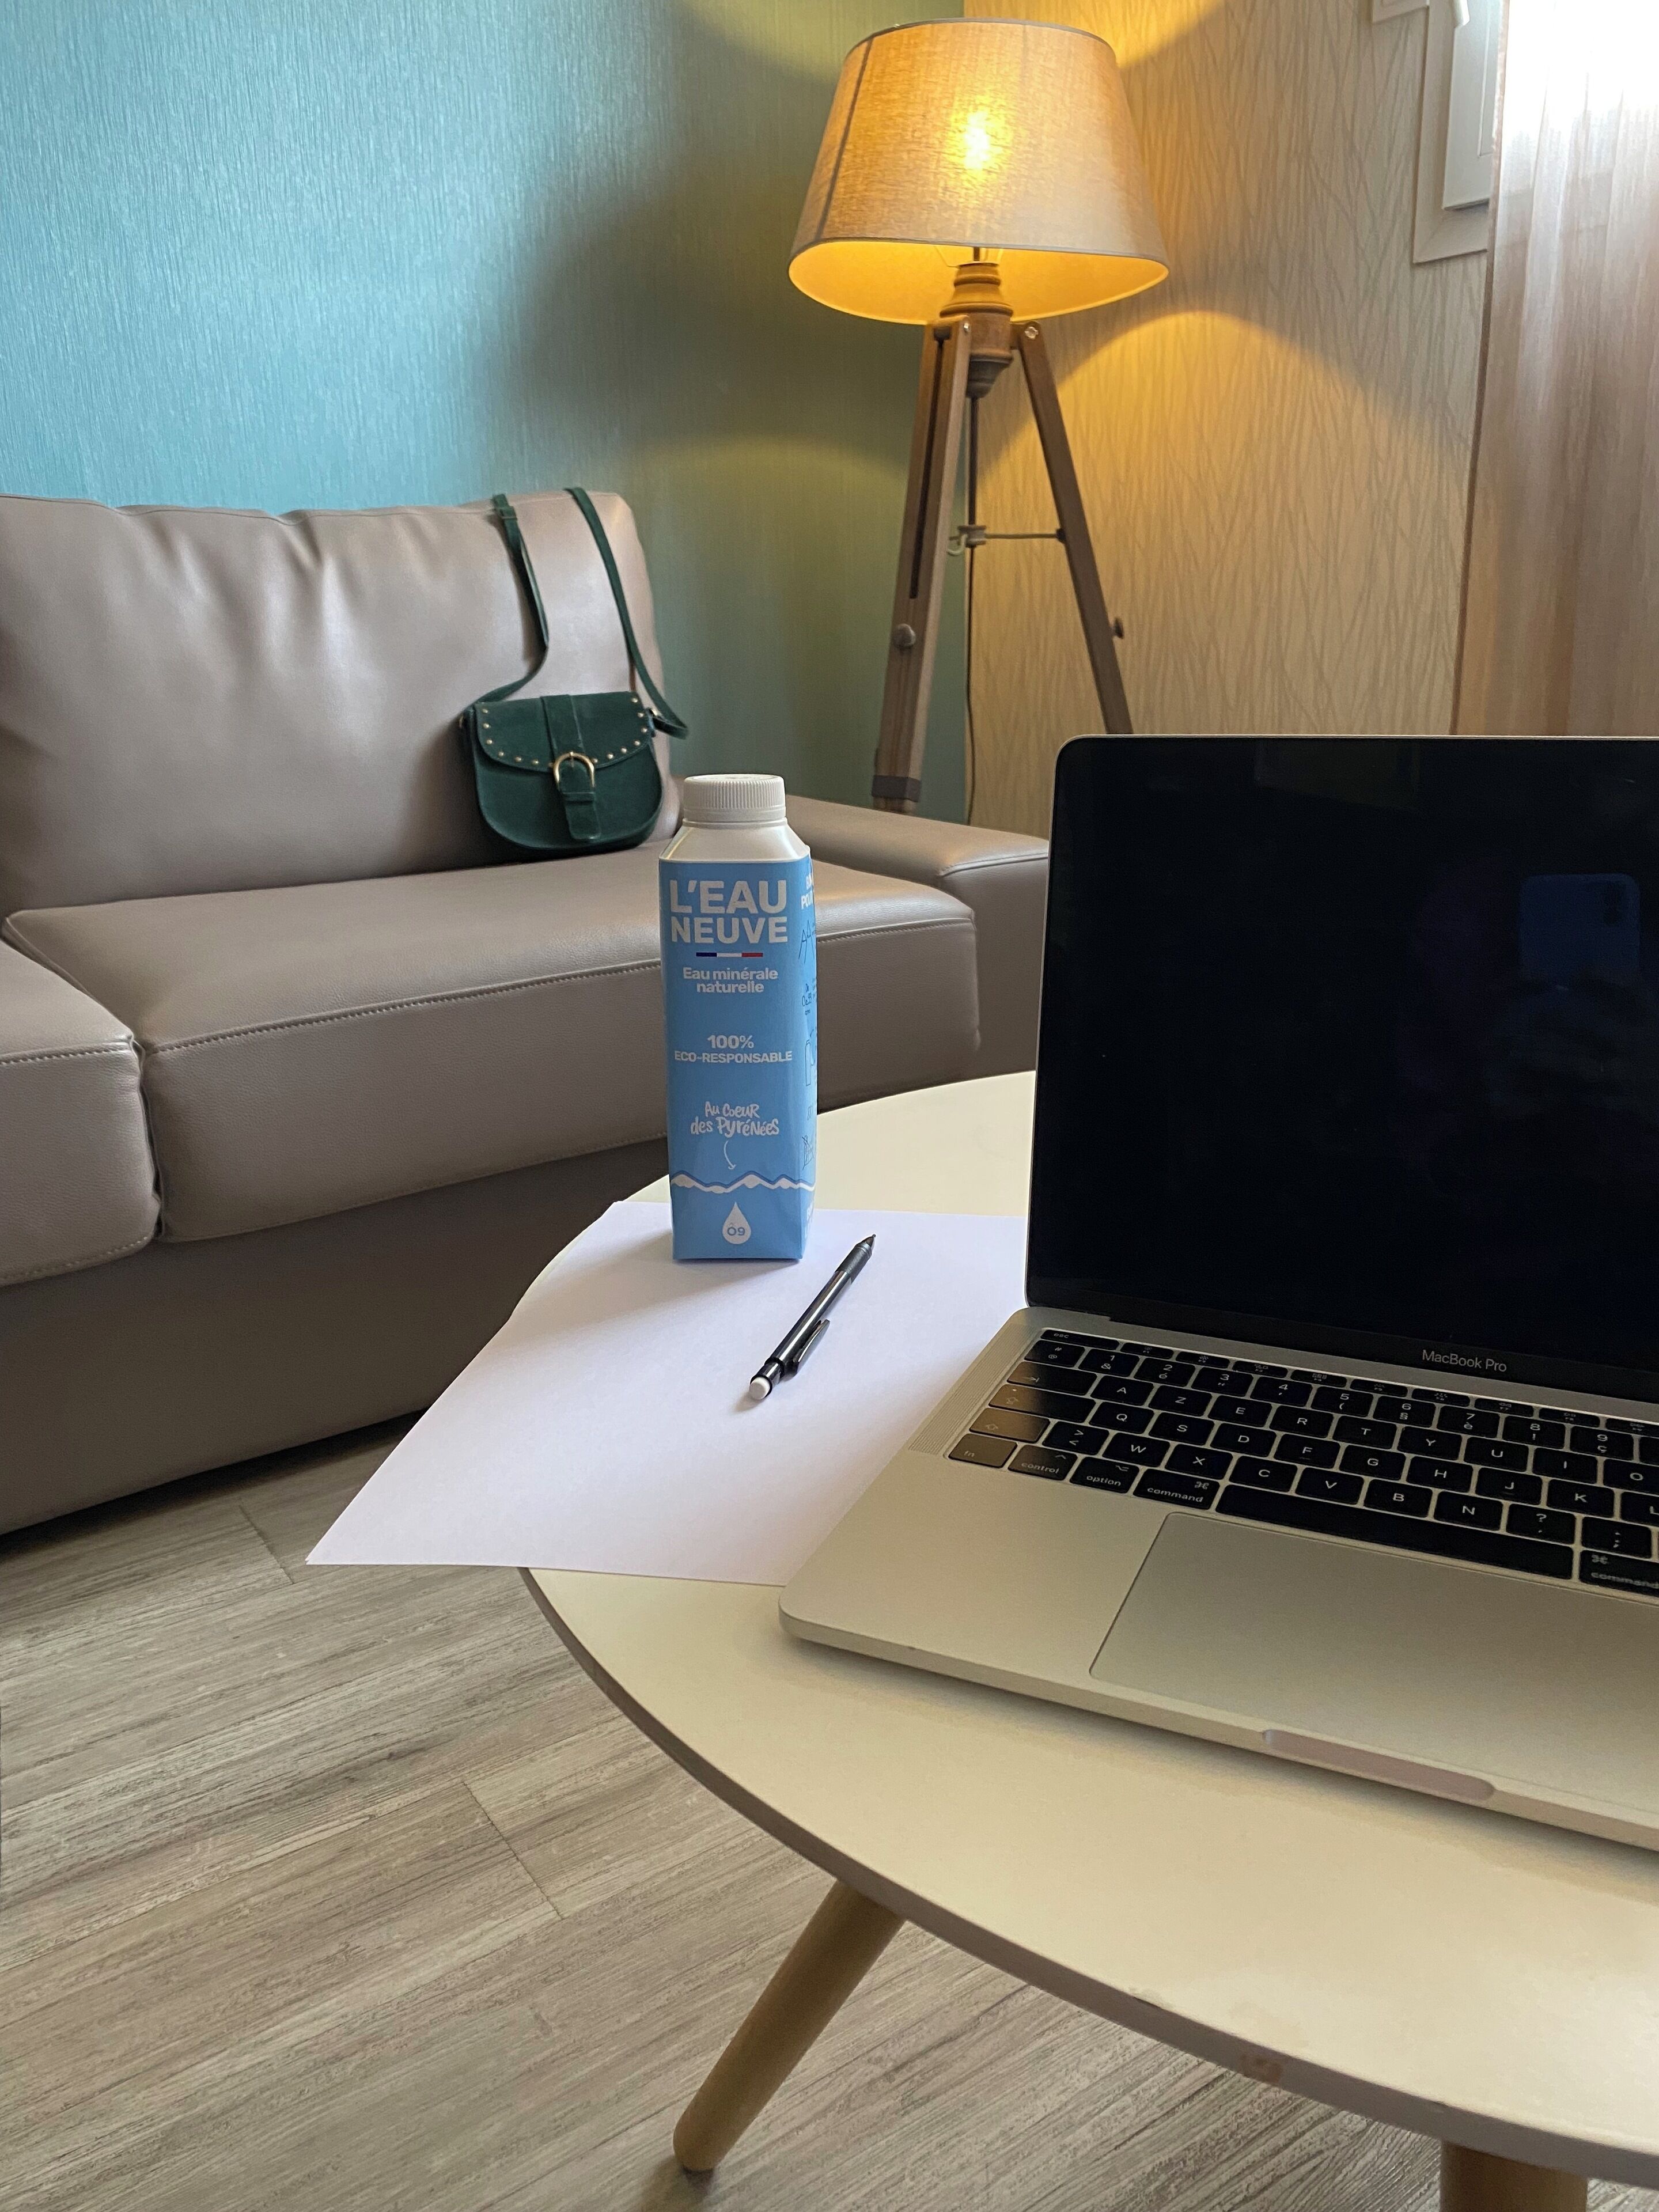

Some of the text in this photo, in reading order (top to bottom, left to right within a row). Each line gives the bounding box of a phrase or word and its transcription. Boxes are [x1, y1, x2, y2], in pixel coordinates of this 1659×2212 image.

[670, 880, 787, 914] L'EAU
[671, 916, 787, 944] NEUVE
[683, 967, 779, 980] Eau minérale
[696, 982, 764, 993] naturelle
[707, 1035, 755, 1049] 100%
[675, 1050, 793, 1064] ECO-RESPONSABLE
[704, 1101, 720, 1118] Au
[690, 1116, 713, 1135] des
[1422, 1349, 1507, 1372] MacBook Pro
[1175, 1396, 1187, 1404] Z
[1235, 1407, 1246, 1415] E
[1116, 1413, 1128, 1422] Q
[1297, 1417, 1308, 1425] R
[1361, 1427, 1371, 1435] T
[1530, 1423, 1540, 1431] 8
[1237, 1435, 1249, 1443] D
[1426, 1438, 1436, 1446] Y
[1597, 1434, 1608, 1442] 9
[1131, 1444, 1146, 1453] W
[1491, 1449, 1503, 1458] U
[1192, 1456, 1206, 1465] X
[1367, 1458, 1379, 1466] G
[1021, 1461, 1060, 1474] control
[1258, 1469, 1270, 1478] C
[1434, 1469, 1447, 1478] H
[1630, 1472, 1643, 1481] O
[1086, 1475, 1122, 1487] option
[1325, 1480, 1337, 1489] V
[1505, 1482, 1514, 1490] J
[1146, 1487, 1204, 1503] command
[1392, 1493, 1404, 1502] B
[1574, 1493, 1587, 1503] K
[1462, 1505, 1475, 1515] N
